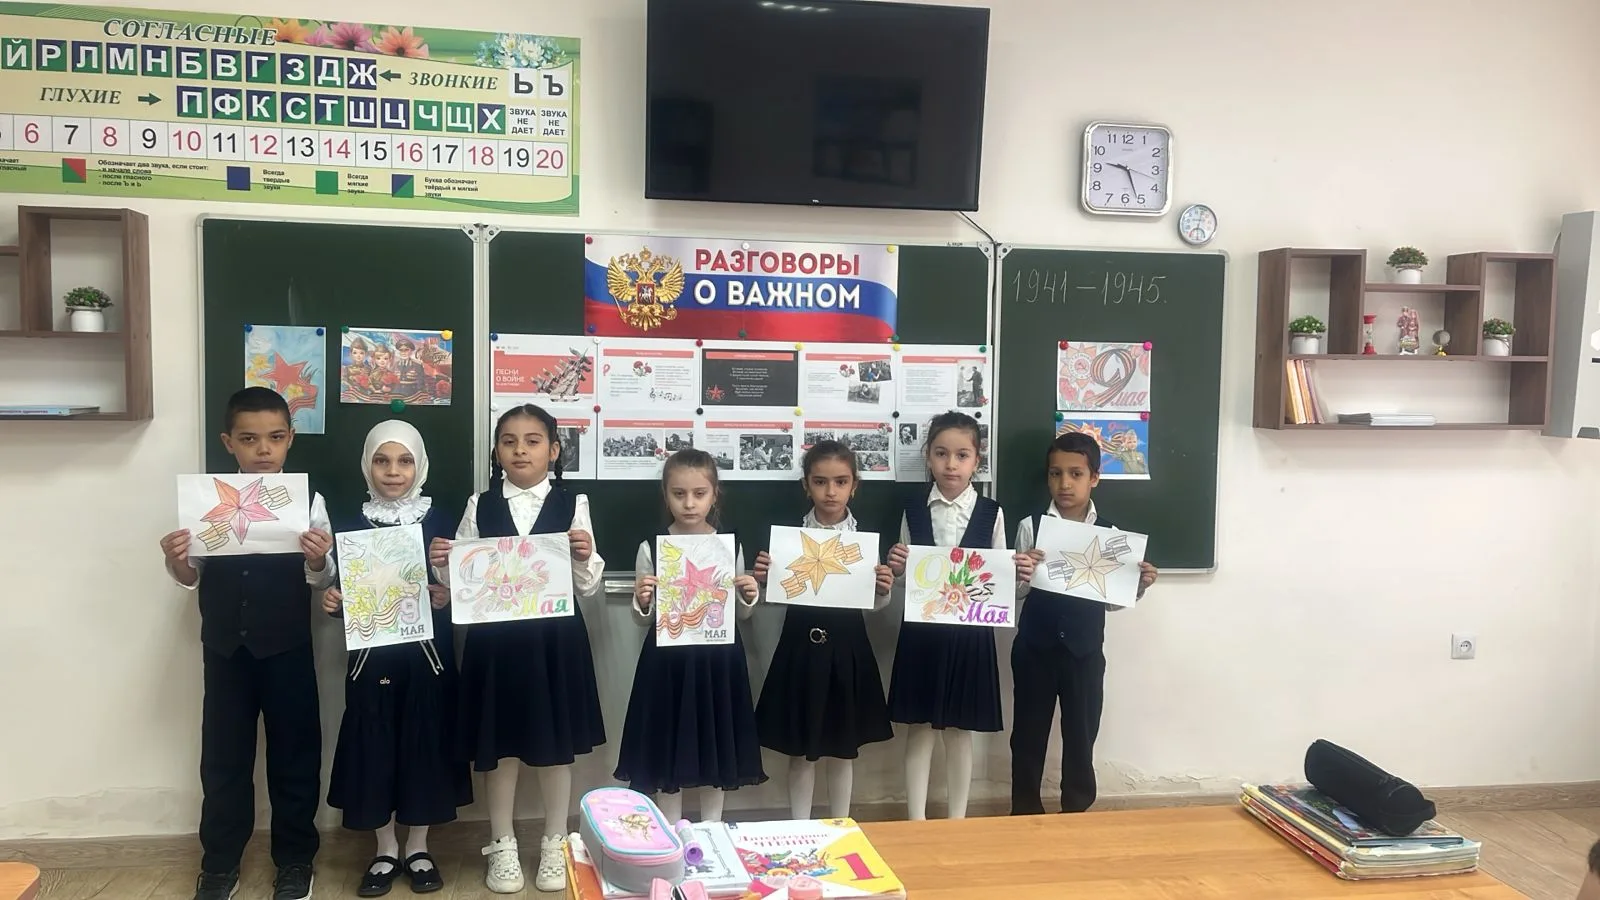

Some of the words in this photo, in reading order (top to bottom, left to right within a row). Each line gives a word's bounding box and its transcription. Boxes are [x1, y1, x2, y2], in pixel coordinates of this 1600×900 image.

[103, 19, 277, 46] СОГЛАСНЫЕ
[5, 39, 29, 68] Й
[41, 44, 62, 67] Р
[76, 45, 98, 69] Л
[109, 48, 135, 71] М
[146, 50, 167, 73] Н
[181, 52, 203, 75] Б
[216, 54, 238, 77] В
[251, 55, 269, 78] Г
[286, 58, 305, 81] З
[318, 60, 341, 85] Д
[348, 62, 377, 86] Ж
[408, 71, 499, 90] ЗВОНКИЕ
[514, 73, 533, 94] Ь
[543, 74, 564, 96] Ъ
[39, 86, 122, 105] ГЛУХИЕ
[181, 91, 202, 114] П
[214, 93, 240, 116] Ф
[252, 95, 270, 118] К
[285, 97, 306, 120] С
[319, 99, 338, 121] Т
[350, 101, 374, 123] Ш
[385, 102, 405, 128] Ц
[418, 105, 437, 127] Ч
[448, 107, 472, 132] Щ
[481, 109, 501, 131] Х
[509, 108, 536, 117] ЗВУКА
[540, 110, 567, 118] ЗВУКА
[517, 117, 529, 125] НЕ
[548, 118, 560, 127] НЕ
[511, 126, 534, 135] ДАЕТ
[542, 128, 565, 136] ДАЕТ
[1108, 134, 1117, 143] 11
[1122, 134, 1134, 144] 12
[1142, 135, 1146, 145] 1
[24, 123, 39, 144] 6
[64, 125, 79, 145] 7
[103, 126, 118, 147] 8
[142, 128, 157, 149] 9
[173, 130, 202, 152] 10
[213, 132, 236, 153] 11
[249, 134, 277, 156] 12
[286, 136, 314, 158] 13
[323, 138, 351, 160] 14
[360, 140, 387, 162] 15
[396, 141, 423, 163] 16
[432, 143, 458, 165] 17
[468, 145, 494, 166] 18
[503, 147, 530, 168] 19
[537, 149, 563, 170] 20
[1094, 145, 1106, 155] 10
[1152, 147, 1161, 157] 2
[98, 159, 136, 167] Обозначает
[1093, 162, 1102, 173] 9
[262, 169, 285, 177] Всегда
[1151, 165, 1160, 175] 3
[1092, 181, 1101, 191] 8
[1150, 184, 1159, 193] 4
[1106, 193, 1114, 203] 7
[1121, 193, 1130, 204] 6
[1137, 194, 1146, 204] 5
[695, 248, 860, 276] РАЗГОВОРЫ
[693, 279, 716, 305] О
[728, 281, 860, 309] ВАЖНОМ
[495, 368, 519, 376] ПЕСНИ
[502, 375, 525, 383] ВОЙНЕ
[959, 601, 1010, 624] Мая
[400, 624, 425, 636] МАЯ
[704, 629, 727, 638] МАЯ
[835, 852, 884, 881] 1
